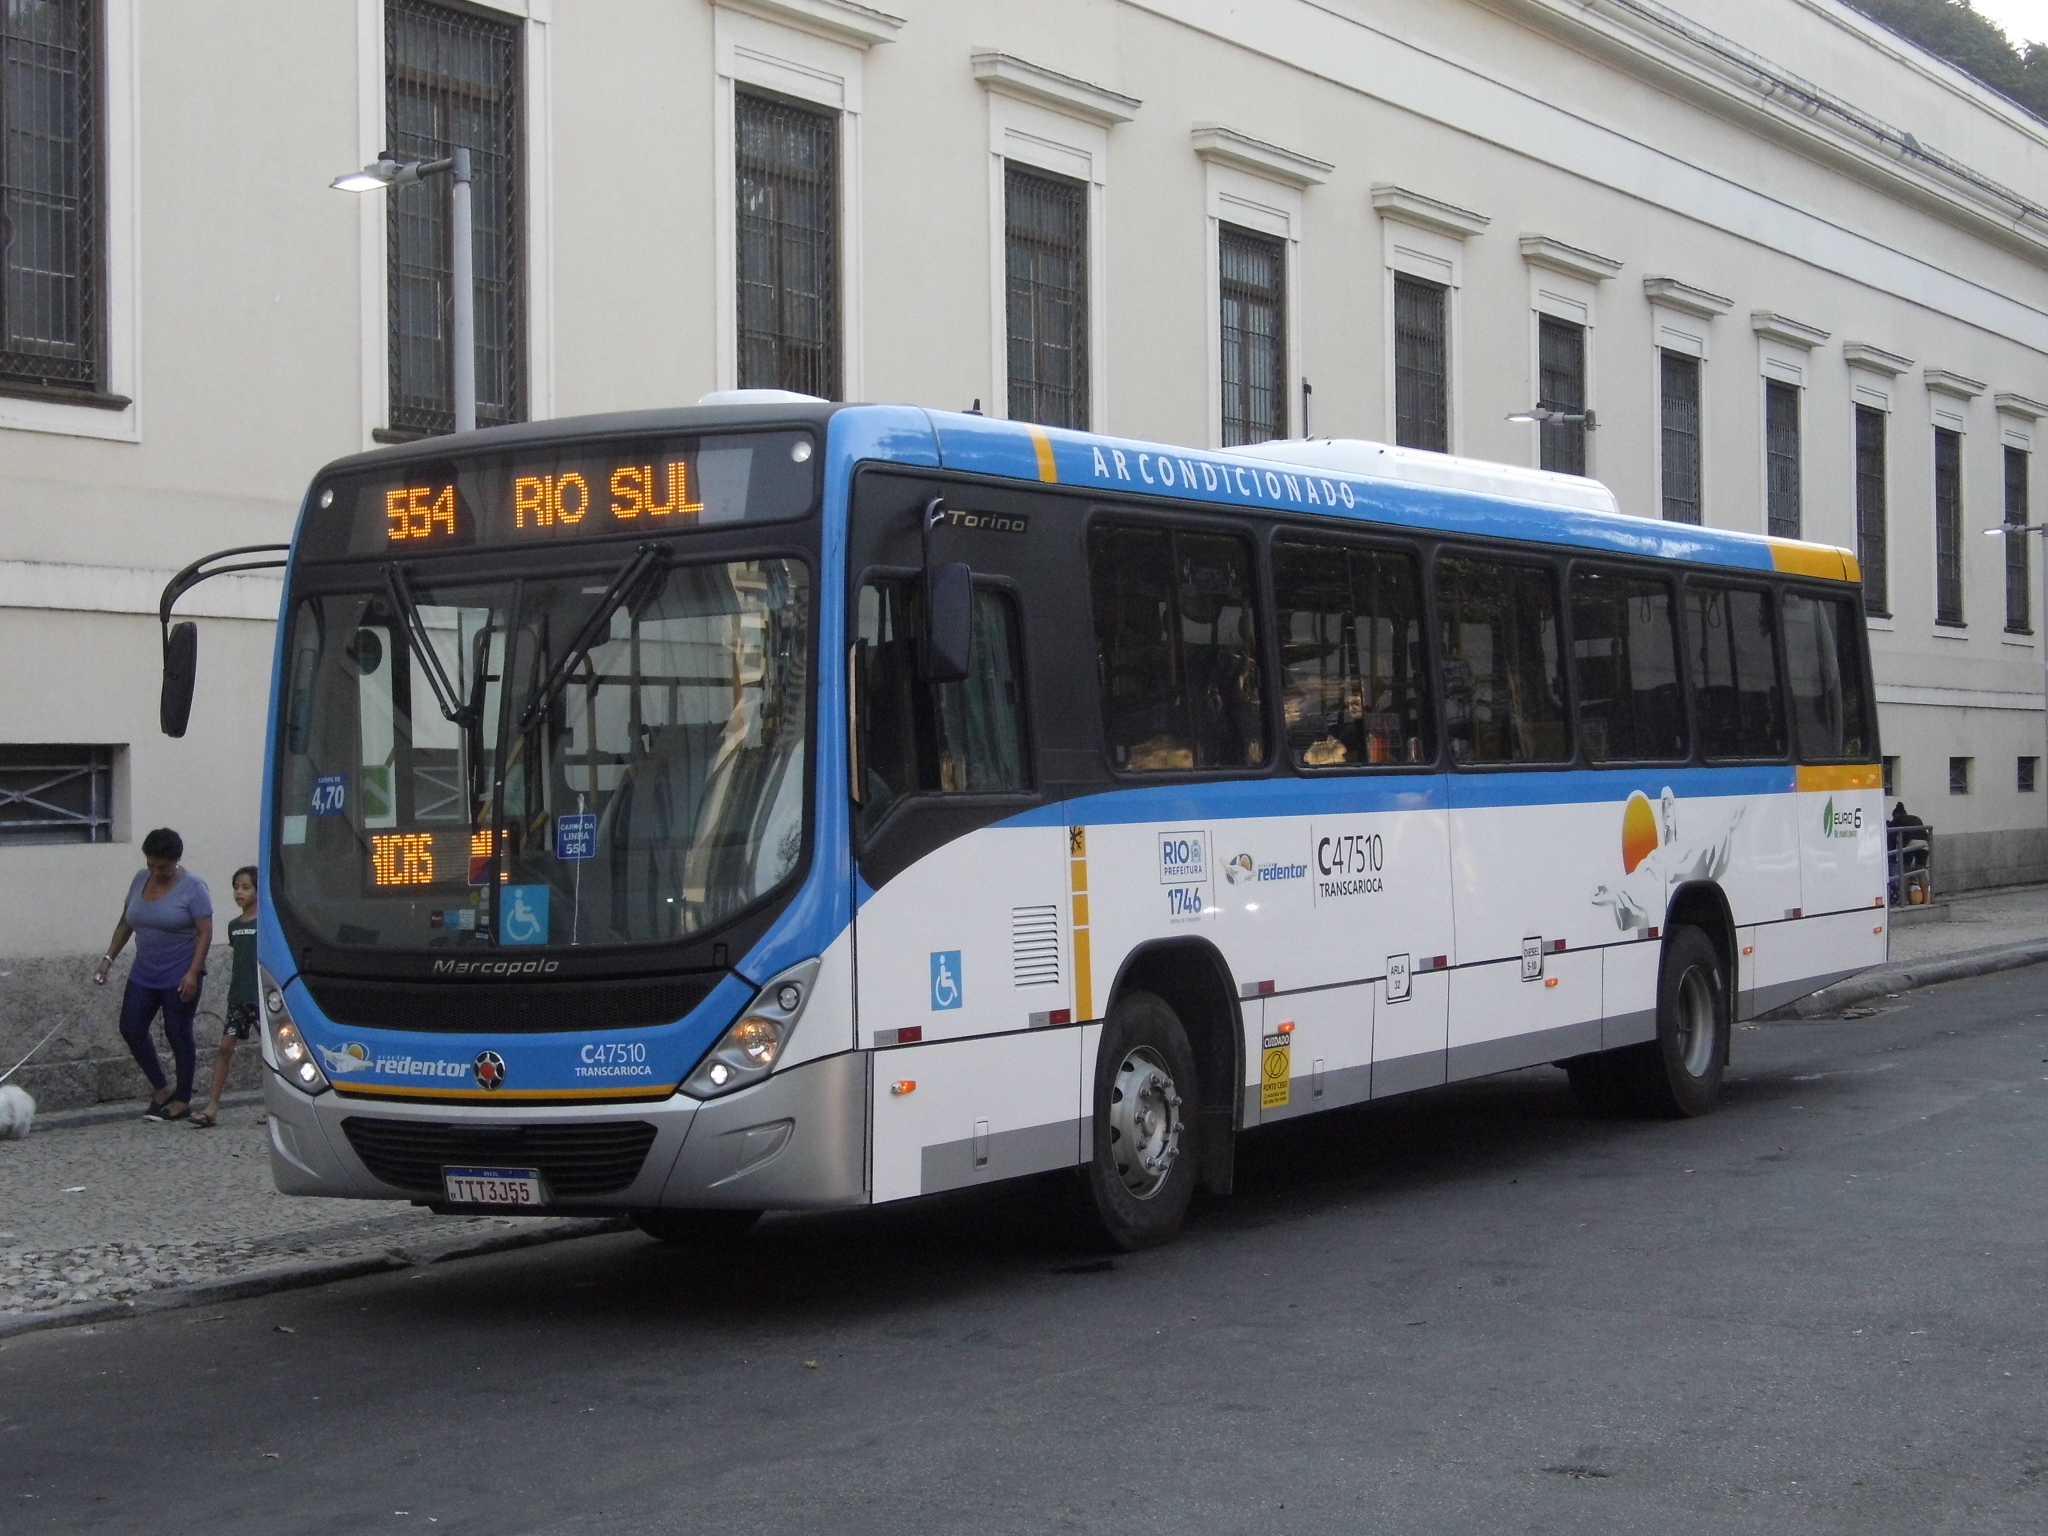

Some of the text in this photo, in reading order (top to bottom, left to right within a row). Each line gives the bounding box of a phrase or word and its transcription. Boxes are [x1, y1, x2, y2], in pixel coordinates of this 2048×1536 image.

[1092, 446, 1355, 509] AR CONDICIONADO
[386, 461, 705, 541] 554 RIO SUL
[947, 509, 1026, 531] Torino
[311, 785, 345, 815] 4,70
[1834, 807, 1862, 829] EURO 6
[563, 832, 589, 841] LINHA
[566, 843, 587, 854] 554
[1163, 840, 1190, 865] RIO
[1317, 833, 1384, 876] C47510
[1164, 866, 1203, 876] PREFEITURA
[1257, 863, 1307, 882] redentor
[1319, 878, 1384, 898] TRANSCARIOCA
[1168, 887, 1202, 915] 1746
[432, 958, 560, 976] Marcopolo
[1264, 1034, 1290, 1048] CUIDADO
[581, 1043, 646, 1064] C47510
[375, 1056, 471, 1077] redentor
[574, 1065, 652, 1077] TRANSCARIOCA
[454, 1180, 531, 1203] TTT3J55
